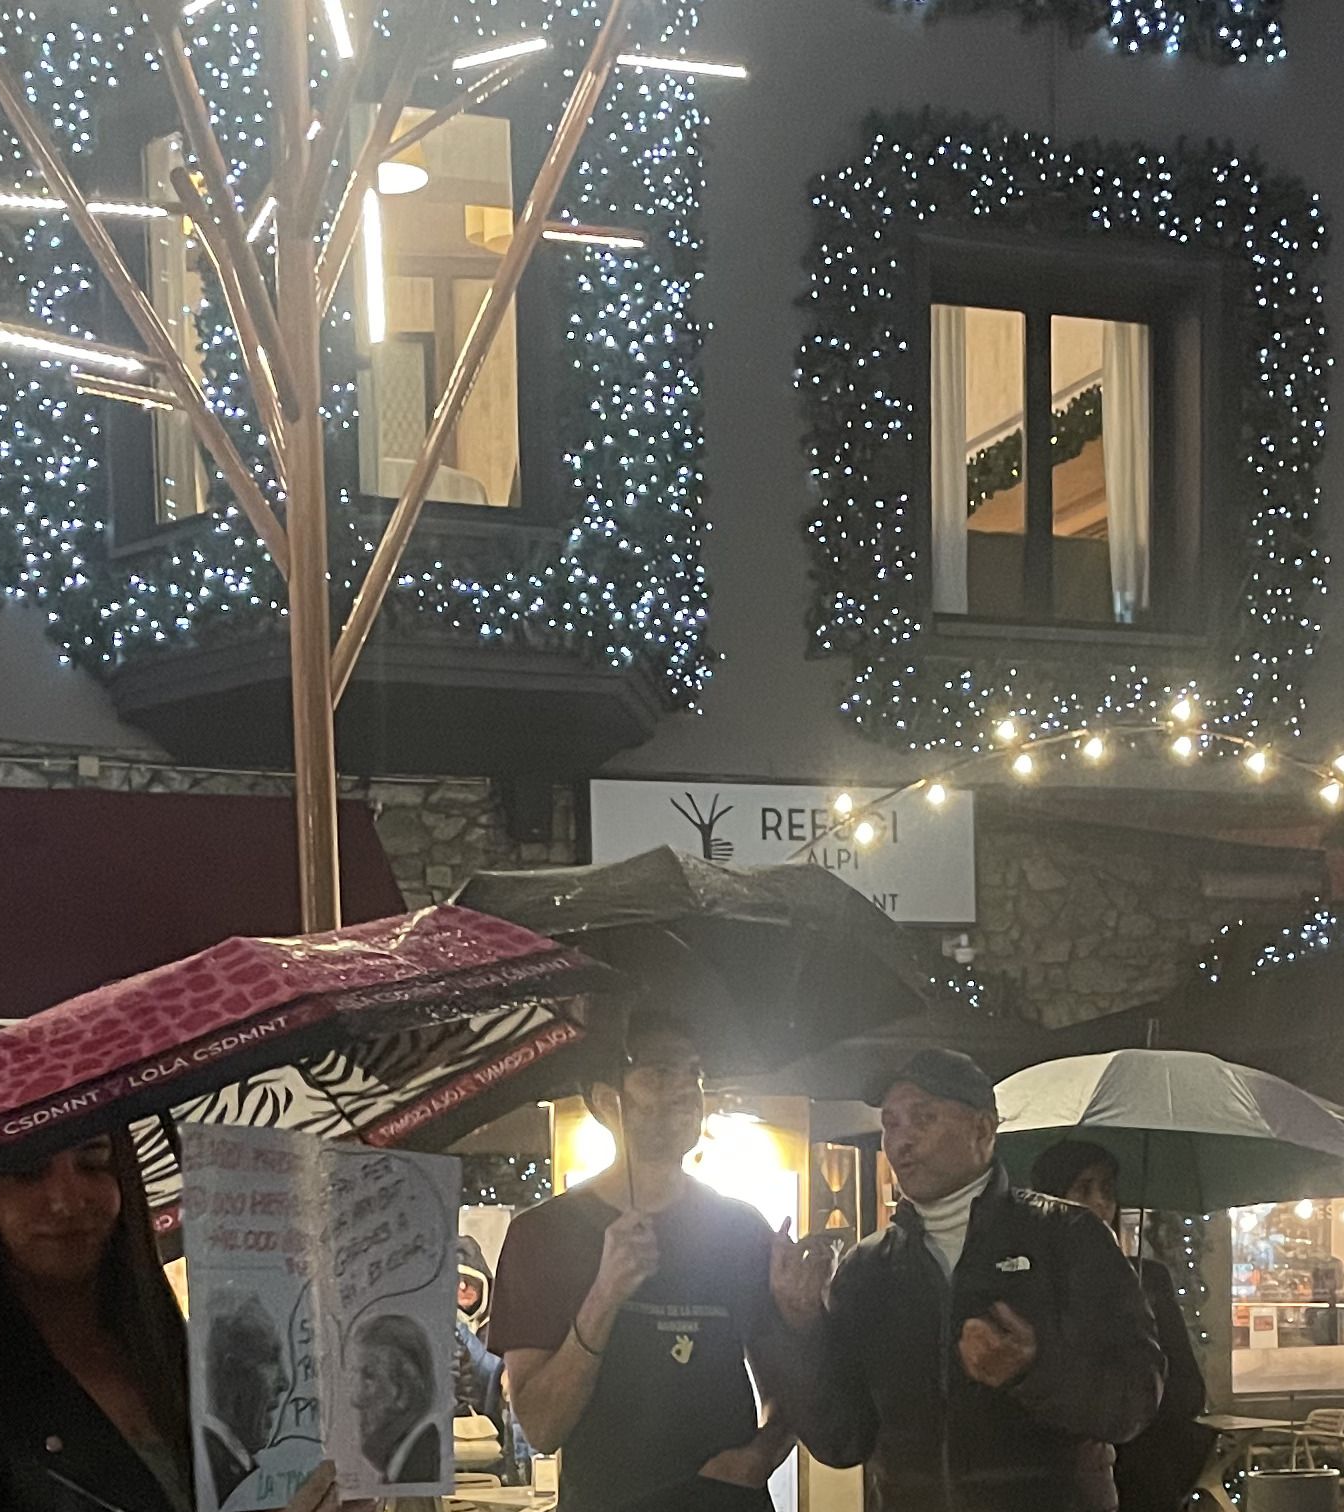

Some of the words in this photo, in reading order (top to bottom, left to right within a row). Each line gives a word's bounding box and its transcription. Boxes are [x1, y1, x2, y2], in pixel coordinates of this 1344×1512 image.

[5, 1089, 101, 1135] CSDMNT
[128, 1057, 190, 1088] LOLA
[193, 1016, 289, 1062] CSDMNT
